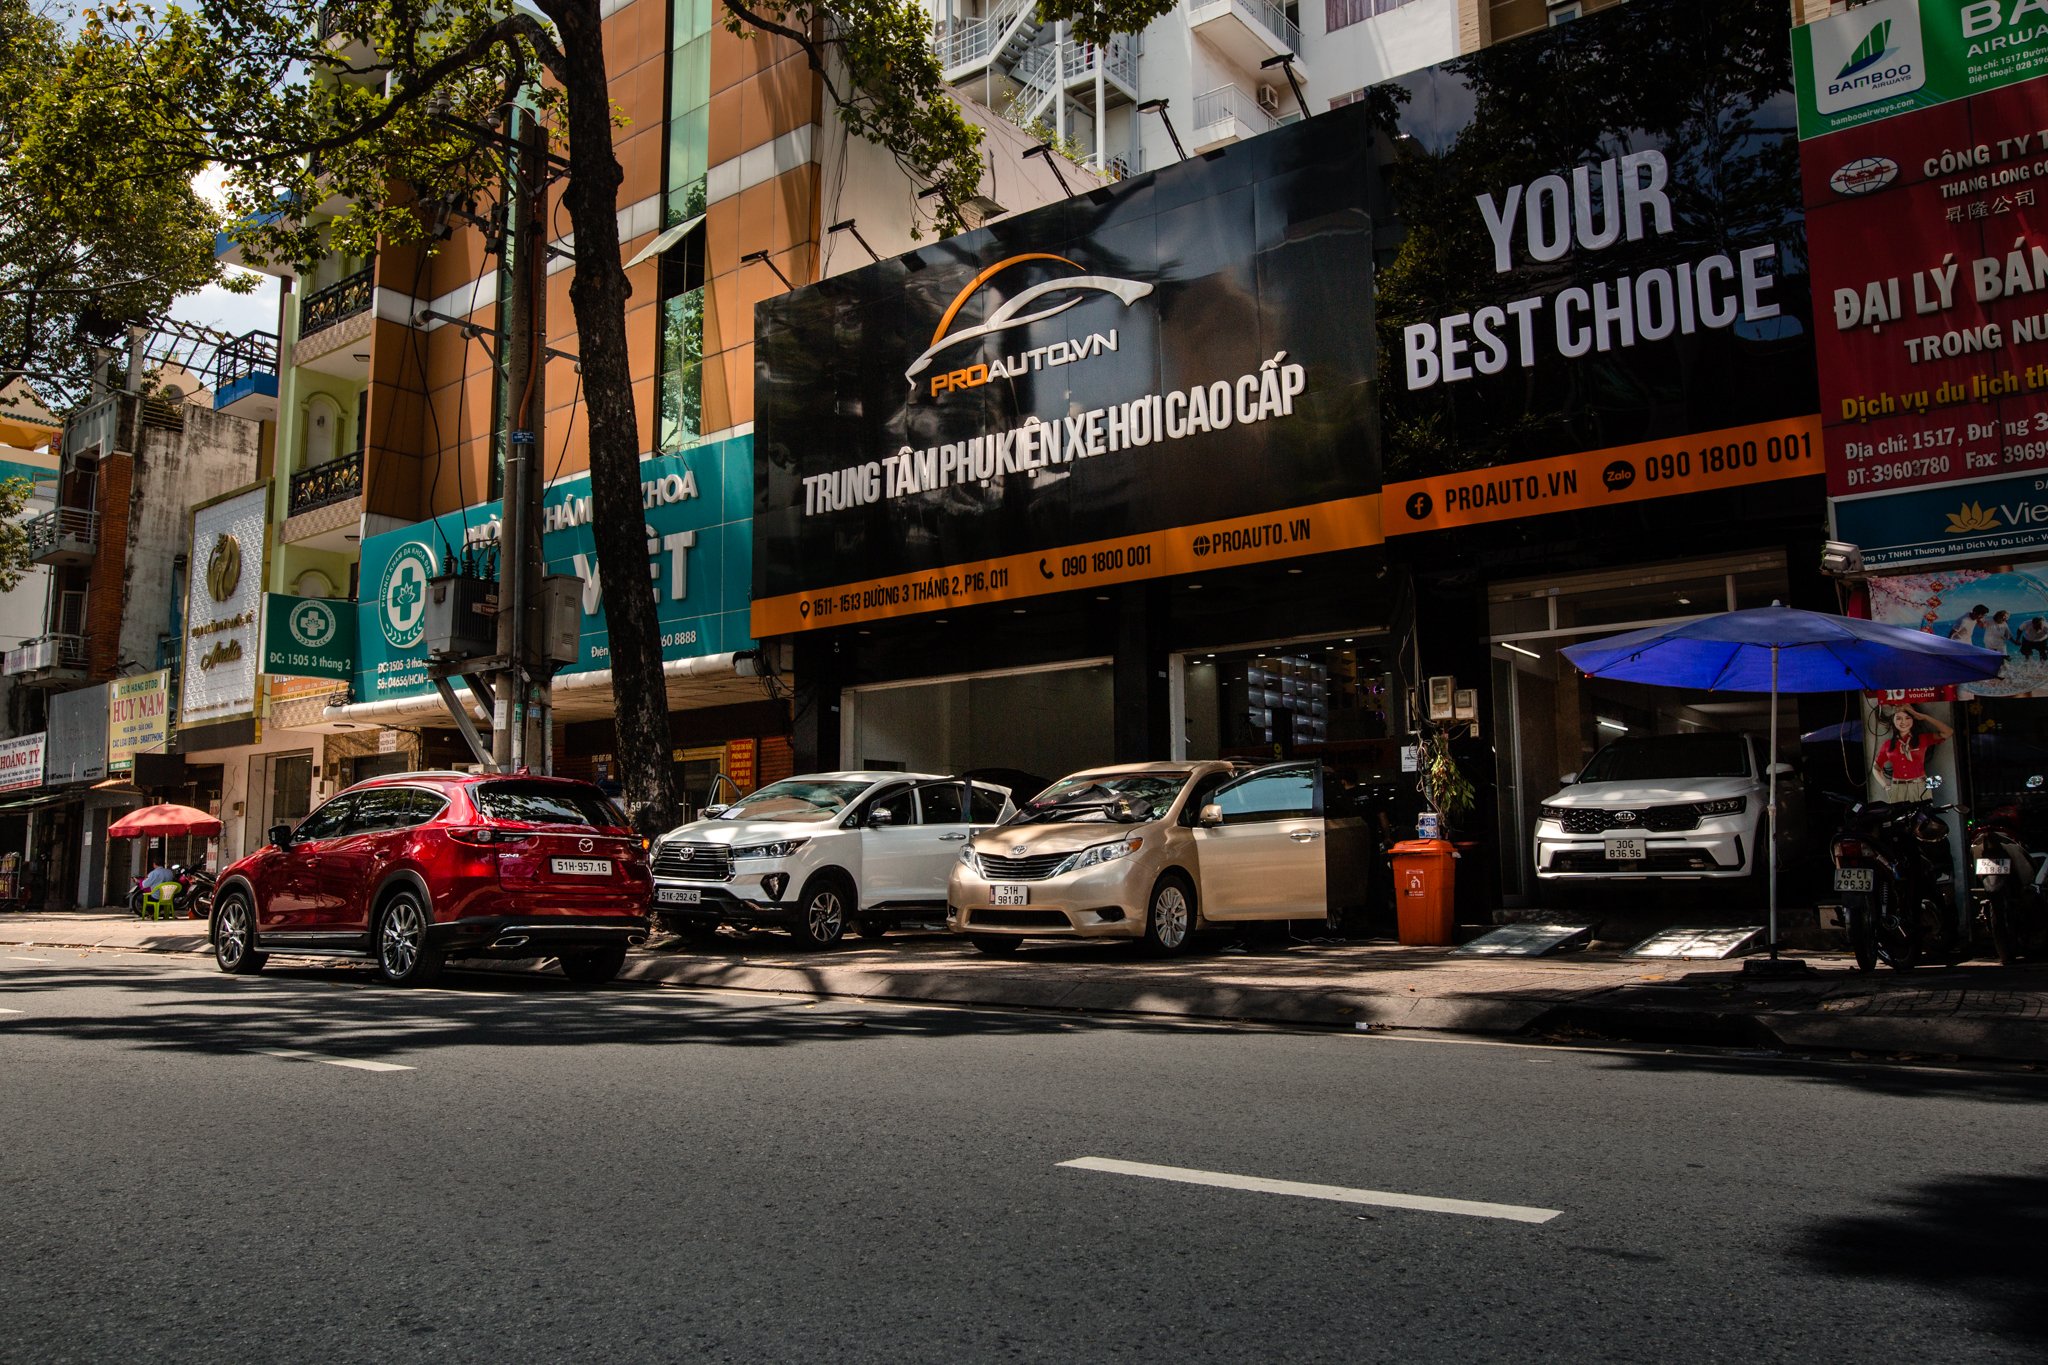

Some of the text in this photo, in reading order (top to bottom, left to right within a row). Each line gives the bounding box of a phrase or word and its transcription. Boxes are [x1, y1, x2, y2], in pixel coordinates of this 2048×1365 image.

[2001, 53, 2020, 65] 1517
[2016, 60, 2032, 71] 028
[1829, 64, 1911, 95] BAMBOO
[1872, 75, 1912, 90] AIRWAYS
[1830, 98, 1915, 127] bambooairways.com
[1923, 148, 1991, 178] CÔNG
[1996, 133, 2031, 160] TY
[1940, 176, 1988, 199] THANG
[1991, 165, 2031, 187] LONG
[1475, 149, 1674, 274] YOUR
[1833, 276, 1902, 334] ĐẠI
[1913, 252, 1959, 316] LÝ
[1403, 243, 1781, 391] BEST CHOICE
[1904, 323, 2003, 364] TRONG
[930, 328, 1119, 398] PROAUTO.VN
[1841, 391, 1895, 424] Dịch
[1901, 389, 1929, 414] vụ
[1935, 380, 1966, 405] du
[1972, 369, 2019, 404] lịch
[802, 350, 1306, 516] TRUNG TÂM PHỤ KIỆN XE HƠI CAO CẤP
[1845, 442, 1874, 463] Địa
[1878, 433, 1909, 455] chỉ:
[1645, 431, 1812, 482] 090 1800 001
[1966, 450, 1998, 470] Fax:
[1445, 469, 1578, 513] PROAUTO.VN
[1606, 469, 1633, 483] Zalo
[1211, 517, 1311, 555] PROAUTO.VN
[1878, 552, 1887, 563] ty
[1888, 549, 1912, 559] TNHH
[2001, 537, 2014, 546] Du
[1062, 544, 1151, 577] 090 1800 001
[813, 600, 832, 617] 1511
[839, 592, 861, 613] 1513
[863, 584, 900, 609] ĐƯỜNG
[902, 584, 909, 603] 3
[912, 576, 949, 601] THÁNG
[951, 576, 962, 597] 2,
[674, 630, 697, 646] 8888
[269, 651, 351, 672] ĐC: 1505 3 tháng 2
[113, 697, 137, 723] HUY
[139, 691, 165, 719] NAM
[1616, 812, 1634, 821] KIA
[1609, 849, 1642, 858] 836.96
[1616, 840, 1634, 849] 30G
[557, 861, 607, 872] 51H-957.16
[1840, 870, 1867, 880] 43-C1
[997, 895, 1024, 905] 981.87
[1003, 886, 1019, 895] 51H
